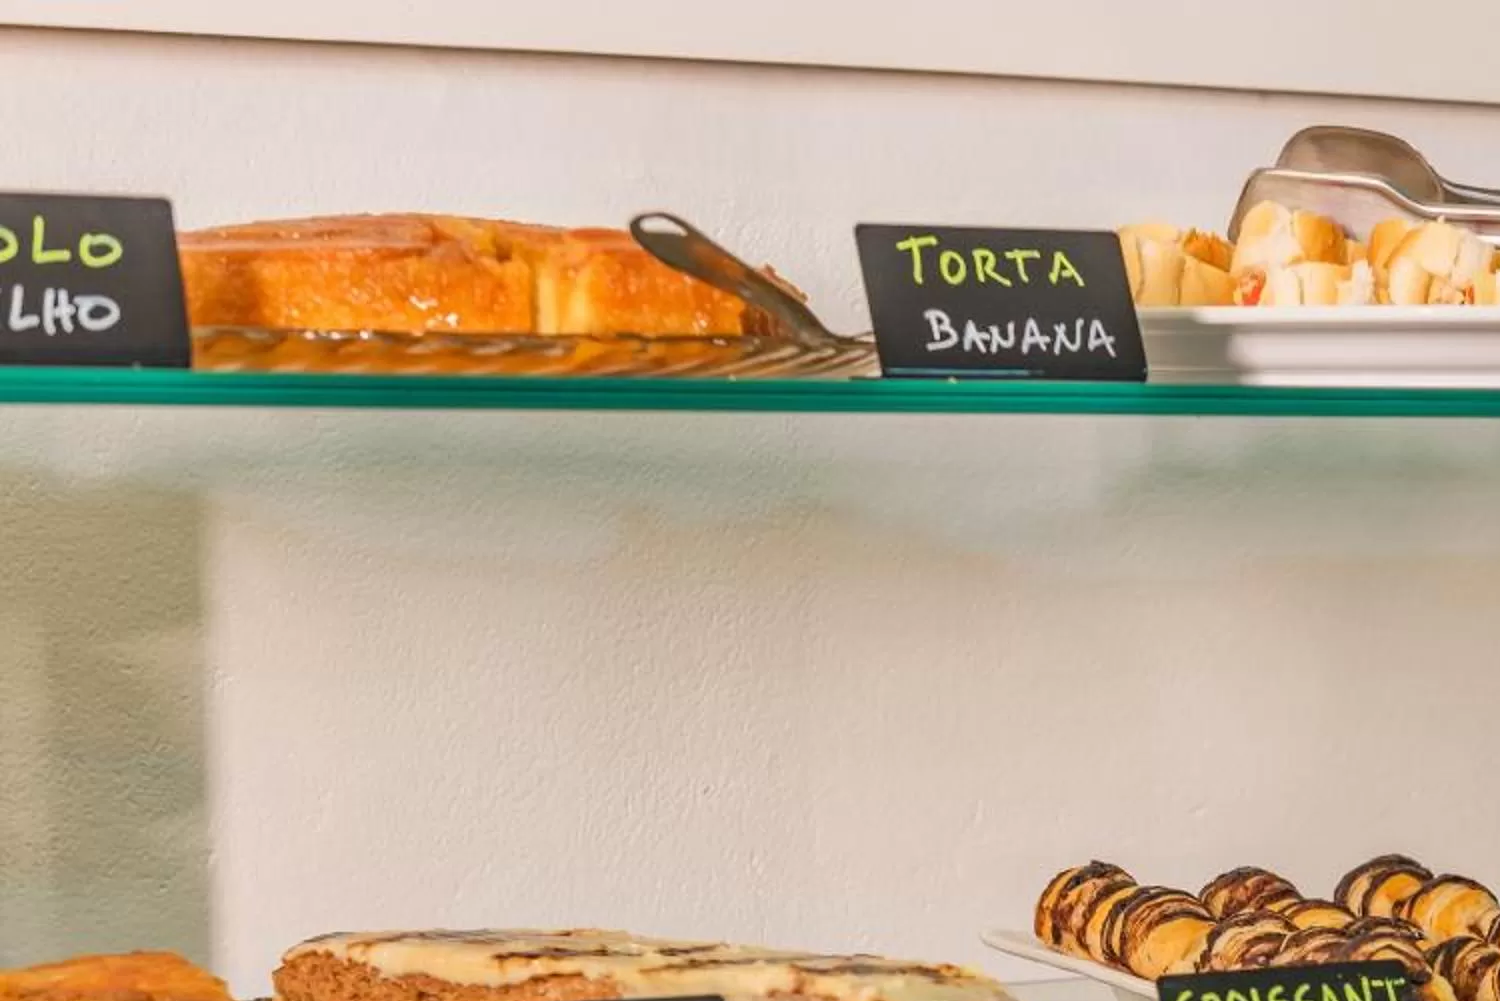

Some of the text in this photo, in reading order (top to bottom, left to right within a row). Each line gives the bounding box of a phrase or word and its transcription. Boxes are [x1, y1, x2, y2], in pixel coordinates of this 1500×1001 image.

[896, 235, 1086, 288] TORTA
[0, 283, 121, 337] LHO
[923, 307, 1117, 358] BANANA
